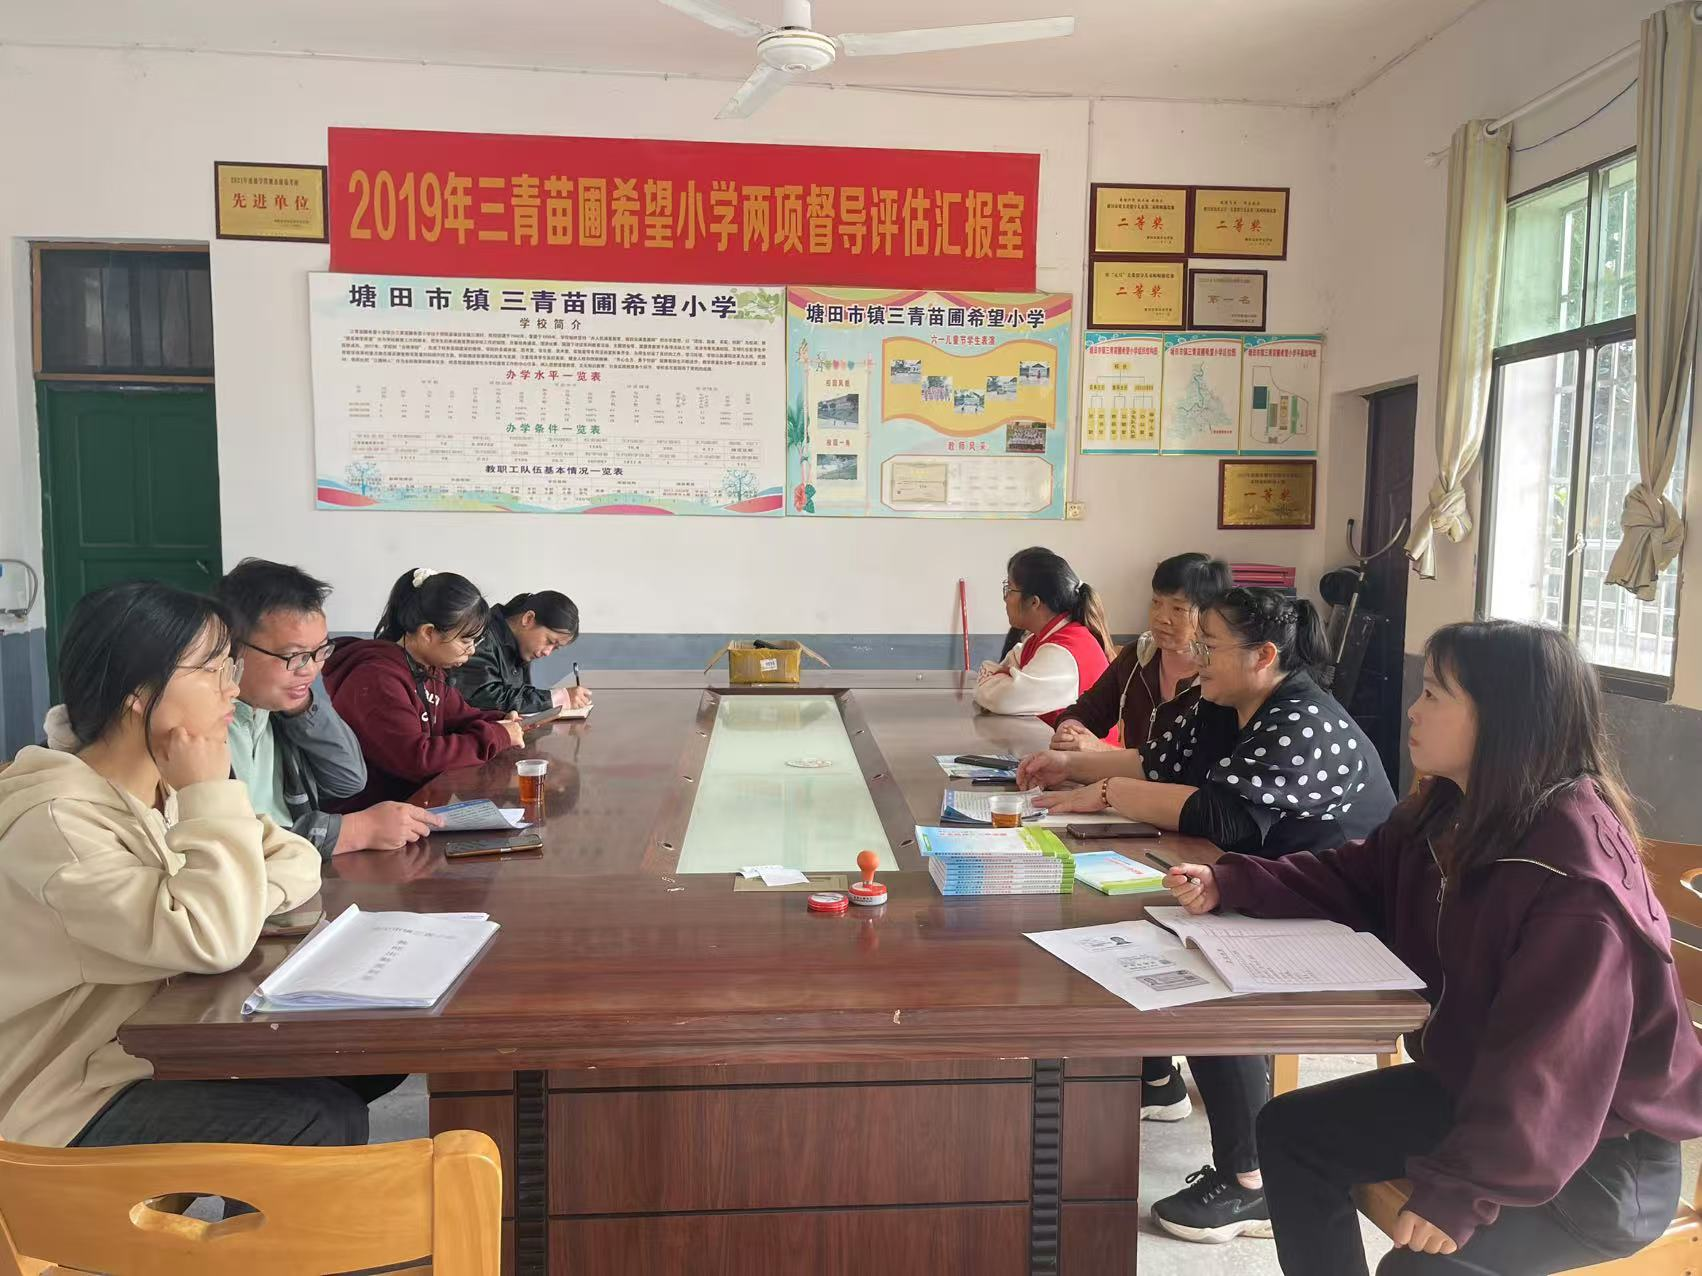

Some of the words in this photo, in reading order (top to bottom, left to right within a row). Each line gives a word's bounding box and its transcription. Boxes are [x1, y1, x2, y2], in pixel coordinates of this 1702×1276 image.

[232, 193, 310, 211] 先进单位
[348, 169, 1025, 259] 2019年三青苗圃希望小学两项督导评估汇报室
[1118, 215, 1164, 231] 二等奖
[1216, 217, 1262, 233] 二等奖
[1116, 282, 1162, 299] 二等奖
[349, 284, 737, 319] 塘田市镇三青苗圃希望小学
[806, 303, 1046, 329] 塘田市镇三青苗圃希望小学
[519, 318, 582, 331] 学校简介
[506, 369, 602, 383] 办学水平一览表
[506, 423, 601, 435] 办学条件一览表
[948, 441, 989, 451] 教师风采
[485, 464, 624, 477] 教职工队伍基本情况一览表
